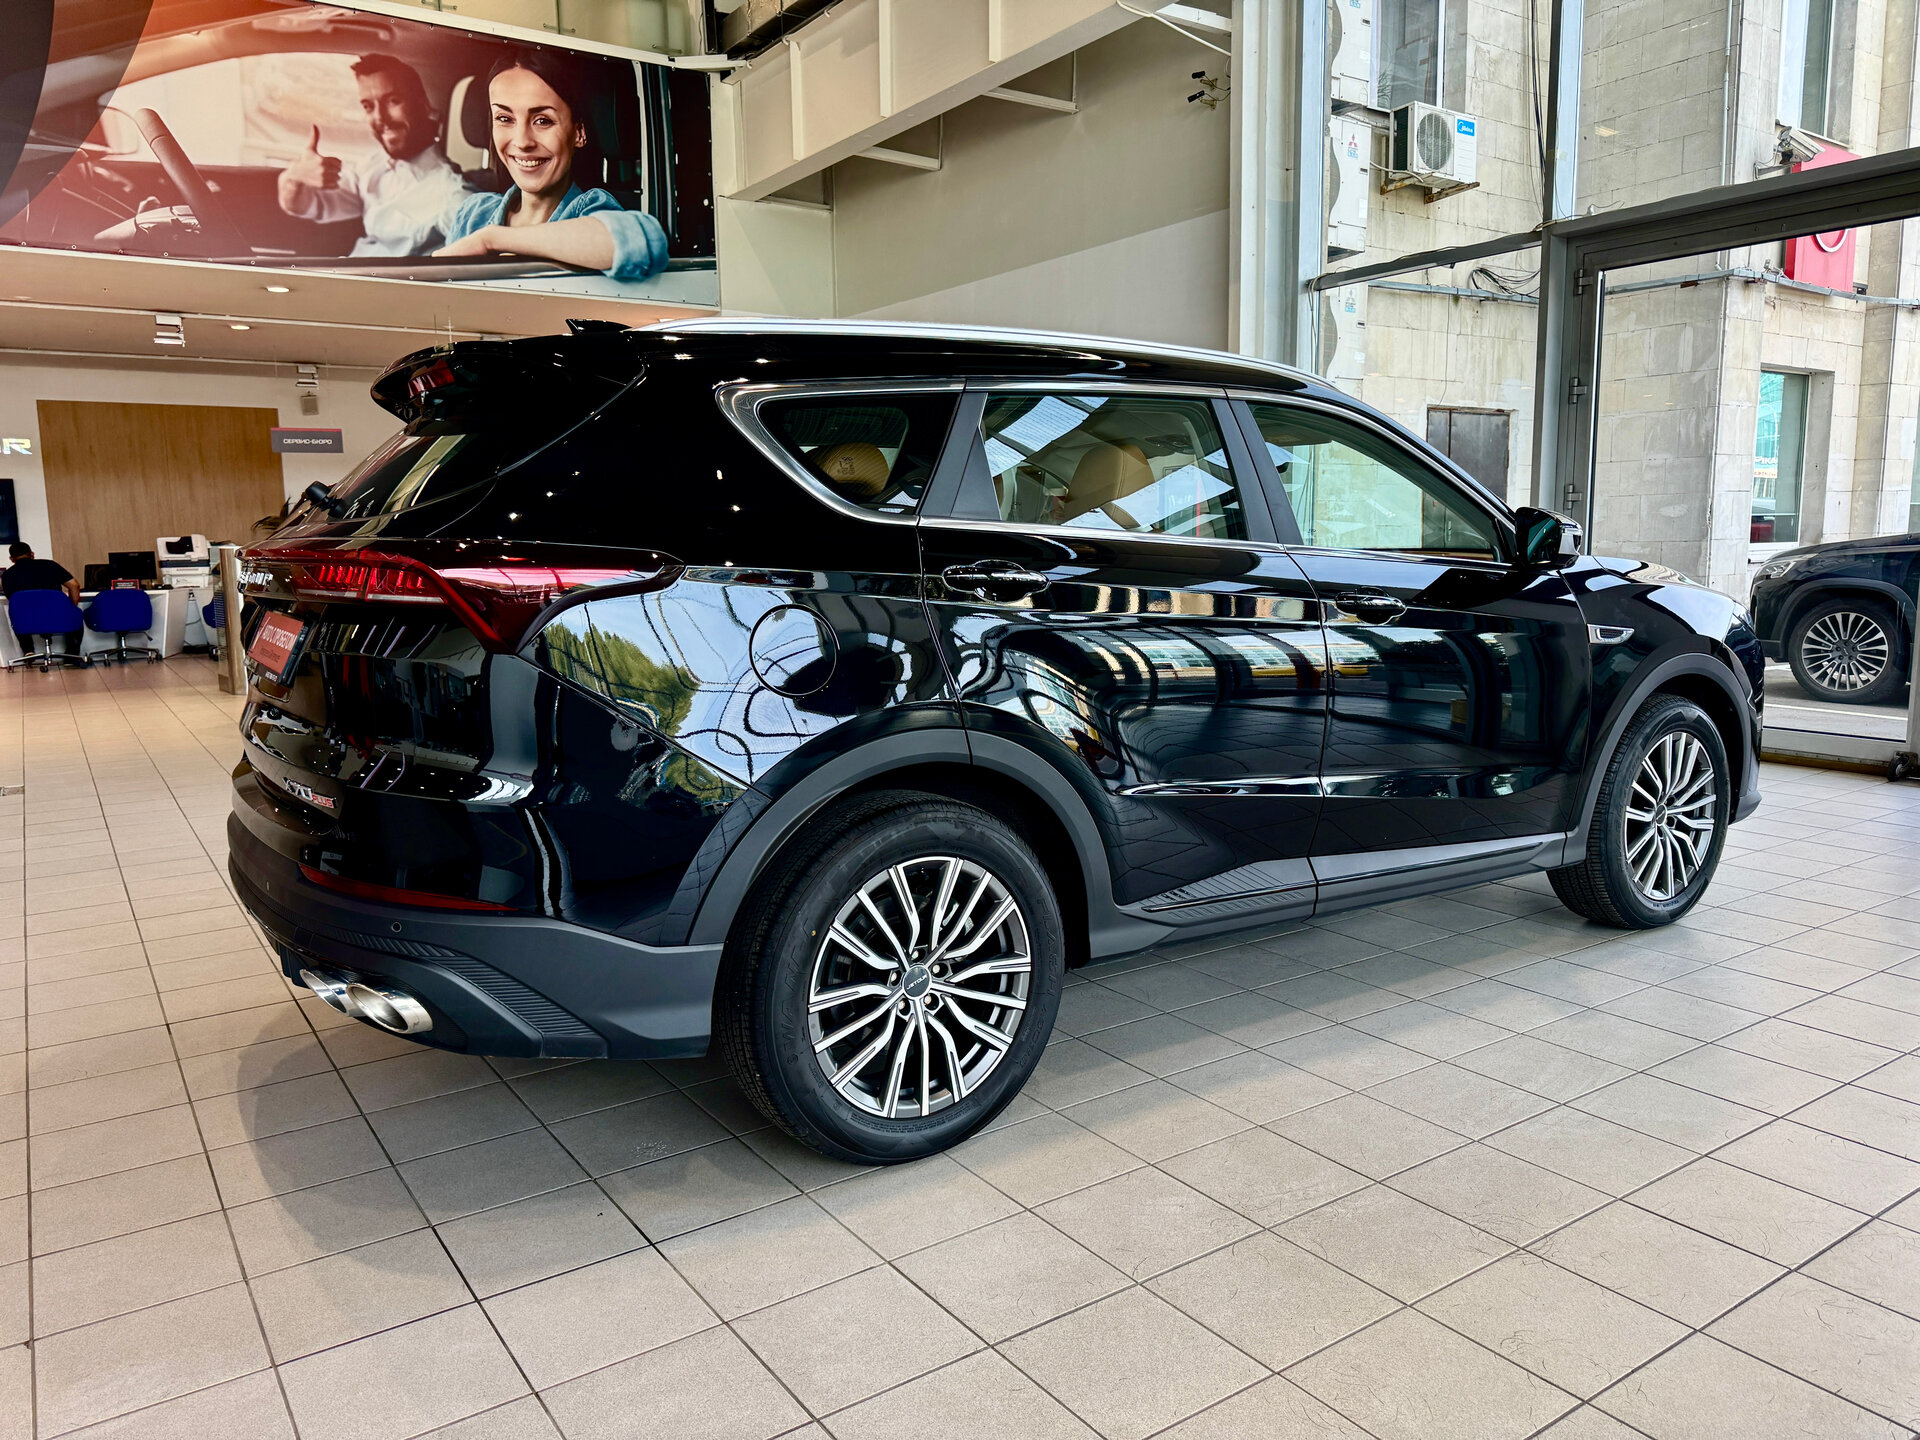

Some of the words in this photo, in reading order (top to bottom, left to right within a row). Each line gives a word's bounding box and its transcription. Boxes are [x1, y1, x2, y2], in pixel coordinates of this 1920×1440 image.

[0, 438, 32, 455] R
[282, 777, 313, 800] X70
[313, 794, 333, 808] PLUS
[906, 974, 927, 990] JETOUR
